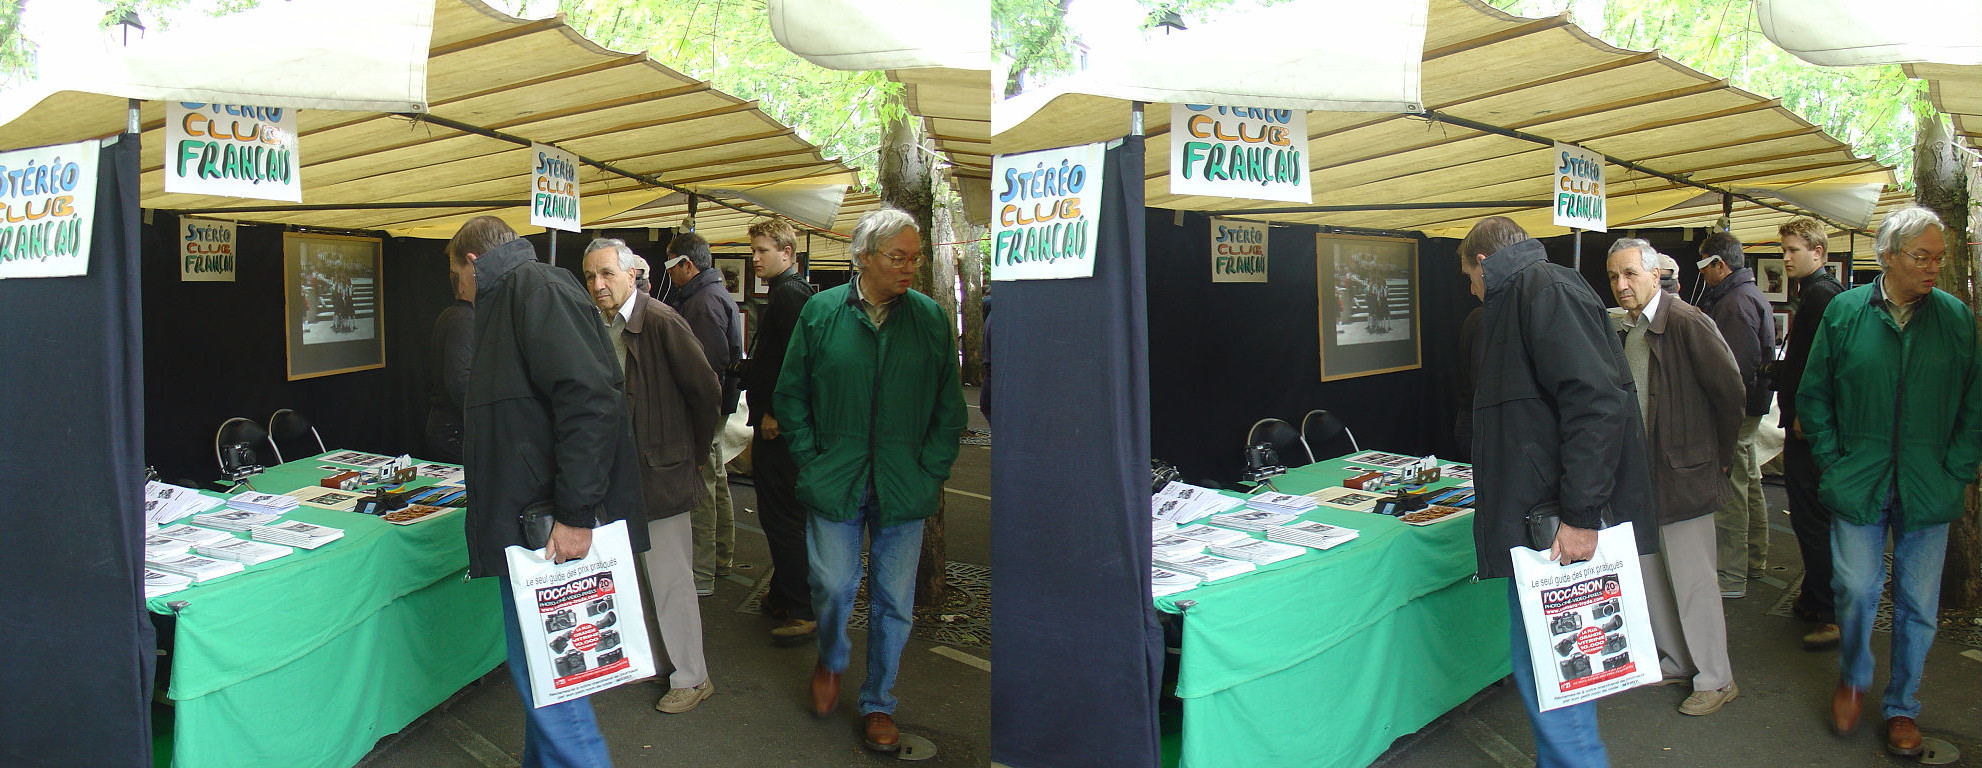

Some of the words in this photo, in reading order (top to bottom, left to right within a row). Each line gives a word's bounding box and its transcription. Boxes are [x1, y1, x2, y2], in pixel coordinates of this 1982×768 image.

[182, 112, 281, 145] CLUB
[1188, 114, 1290, 146] CLUB
[177, 139, 291, 185] FRANÇAIS
[536, 151, 575, 182] STÉRÉO
[1182, 141, 1300, 186] FRANÇAIS
[1559, 151, 1600, 182] STÉRÉO
[537, 176, 574, 196] CLUB
[1000, 159, 1086, 203] STÉRÉO
[1560, 175, 1599, 196] CLUB
[1001, 198, 1081, 227] CLUB
[0, 213, 82, 264] RANÇAIS
[185, 224, 231, 242] STÉRÉO
[995, 215, 1088, 267] FRANÇAIS
[1216, 225, 1262, 244] STÉRÉO
[187, 243, 230, 254] CLUB
[1218, 244, 1262, 255] CLUB
[549, 572, 566, 584] guide
[566, 569, 577, 579] des
[577, 564, 589, 577] prix
[1531, 580, 1539, 588] Le
[1540, 576, 1554, 586] seul
[1554, 573, 1571, 586] guide
[1571, 571, 1582, 580] des
[1583, 566, 1595, 578] prix
